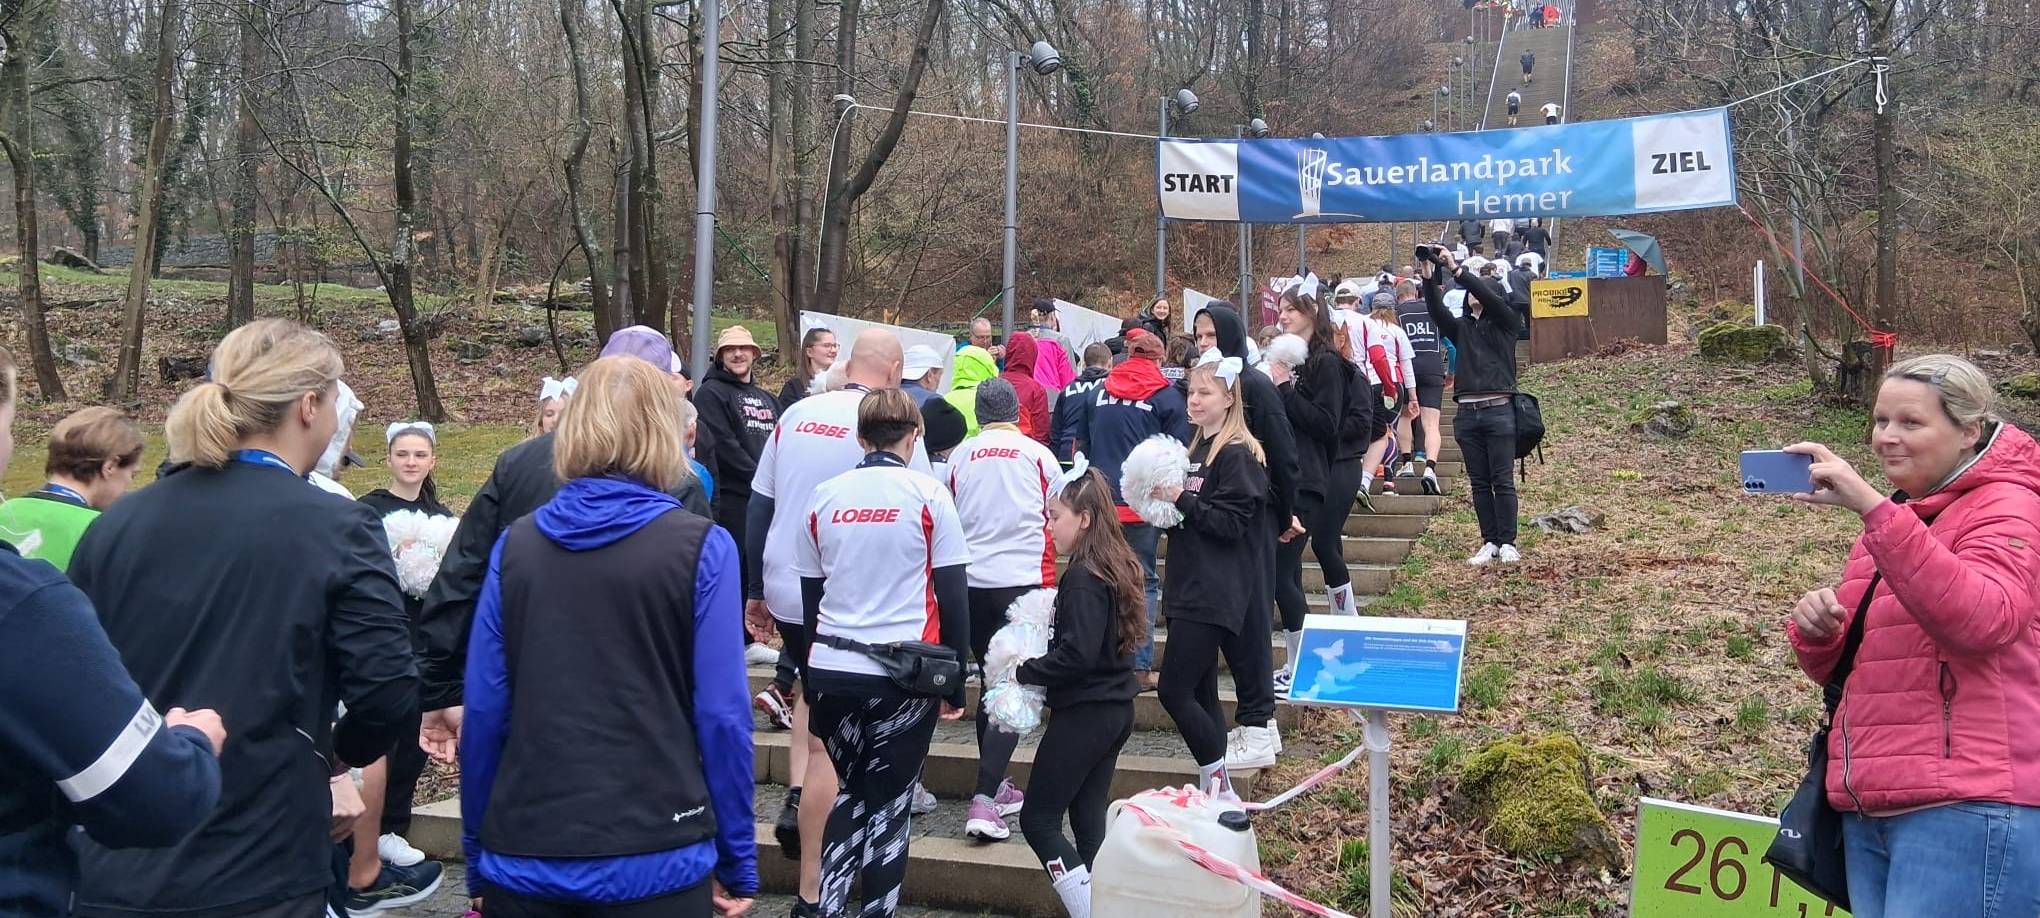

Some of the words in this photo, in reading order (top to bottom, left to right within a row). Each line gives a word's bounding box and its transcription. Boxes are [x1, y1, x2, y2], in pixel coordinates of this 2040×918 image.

[1326, 149, 1573, 187] Sauerlandpark
[1652, 151, 1711, 175] ZIEL
[1163, 173, 1235, 194] START
[1457, 190, 1573, 216] Hemer
[1405, 322, 1435, 336] D&L
[795, 420, 851, 439] LOBBE
[970, 447, 1020, 462] LOBBE
[832, 508, 901, 524] LOBBE
